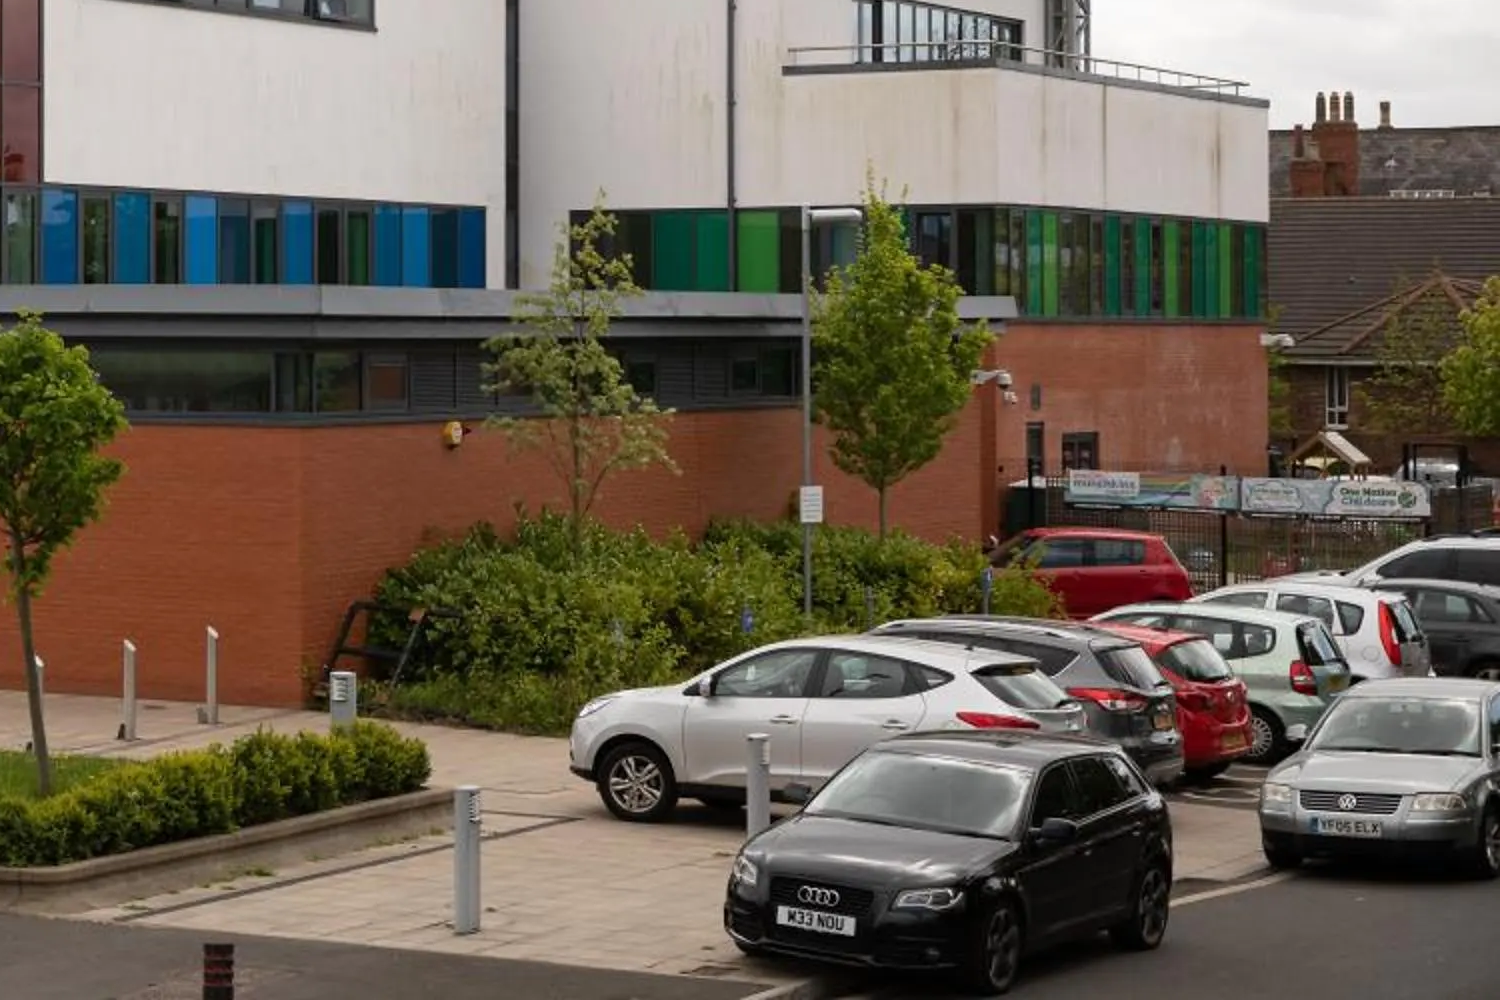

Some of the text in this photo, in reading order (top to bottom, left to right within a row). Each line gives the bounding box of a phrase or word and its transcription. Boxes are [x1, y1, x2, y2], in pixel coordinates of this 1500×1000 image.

[1339, 487, 1397, 497] One Nation
[1355, 821, 1379, 833] ELX
[817, 913, 845, 931] NOU
